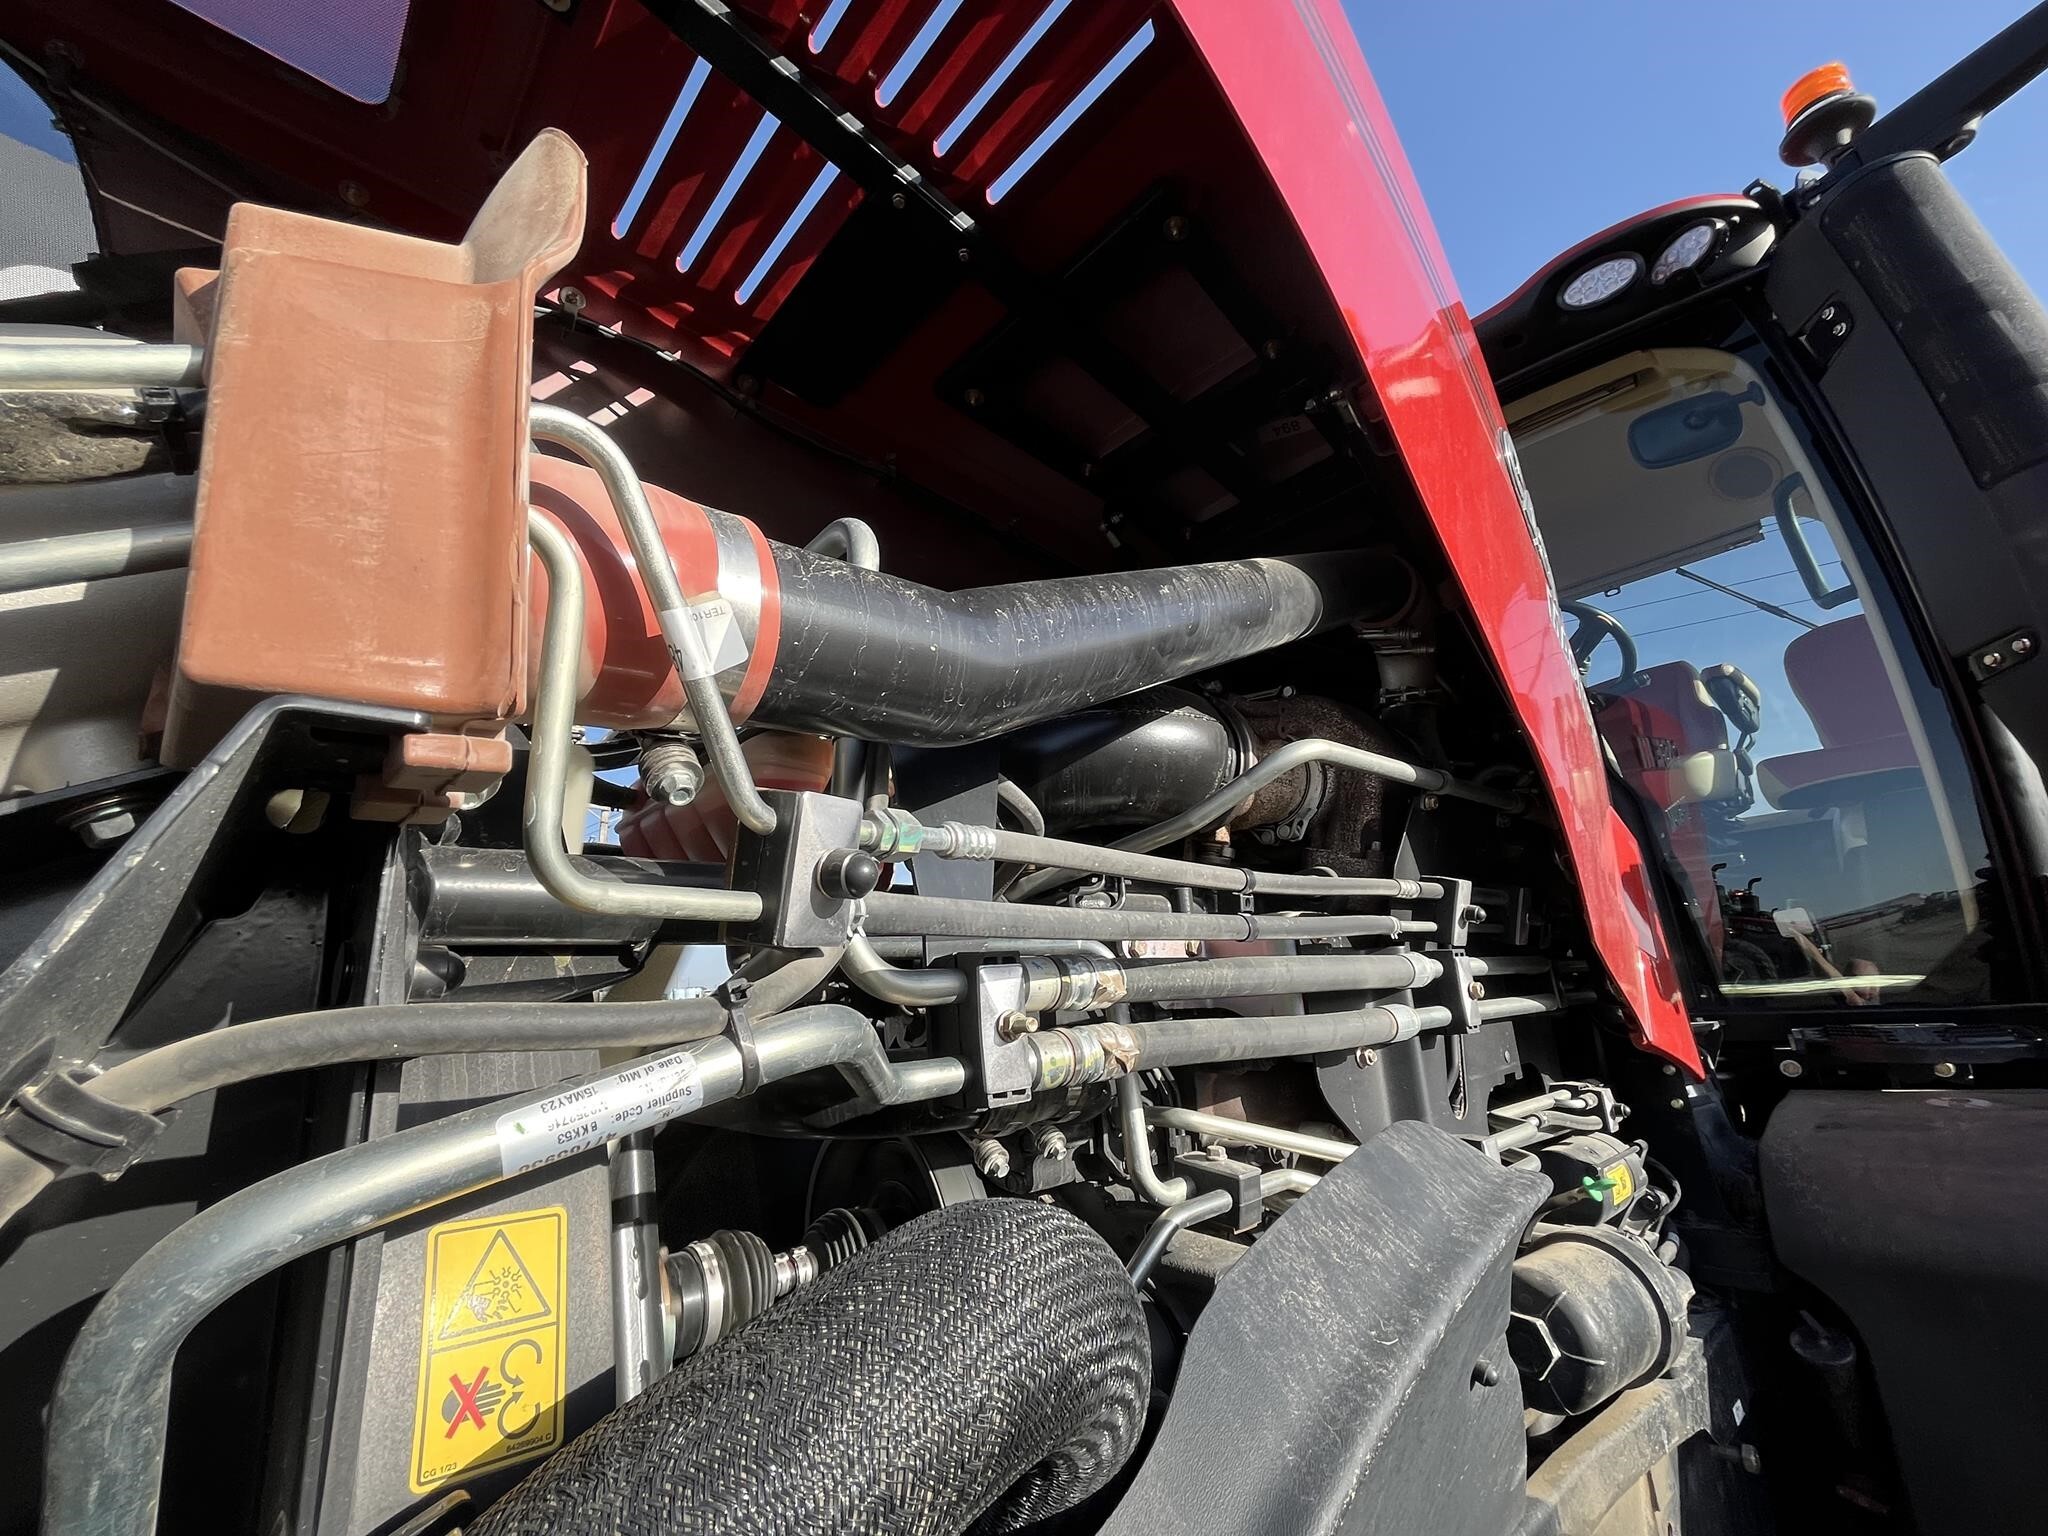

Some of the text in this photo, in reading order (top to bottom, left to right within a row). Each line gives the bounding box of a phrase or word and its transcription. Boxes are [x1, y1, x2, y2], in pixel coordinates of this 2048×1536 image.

[541, 1086, 599, 1114] 15MAY23
[647, 1086, 692, 1110] Supplier
[558, 1120, 598, 1145] BKK53
